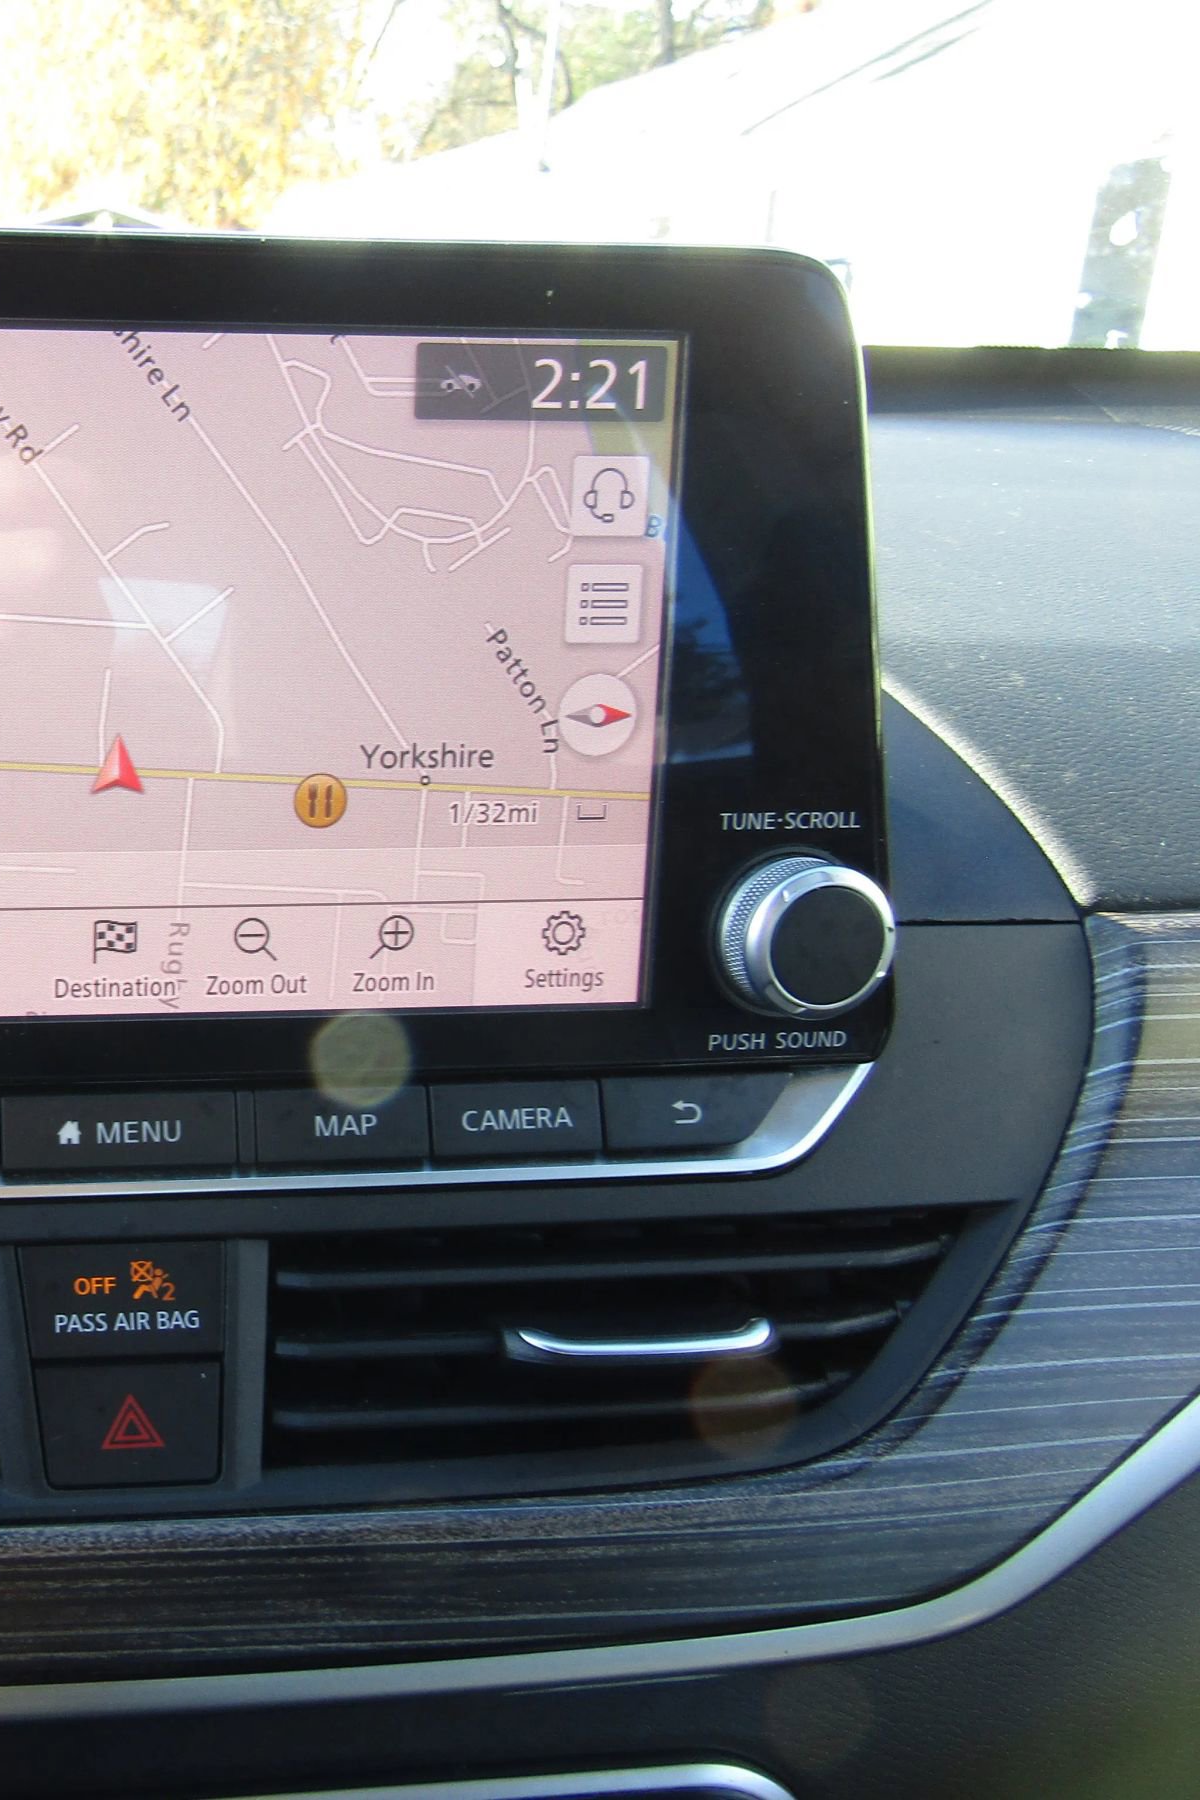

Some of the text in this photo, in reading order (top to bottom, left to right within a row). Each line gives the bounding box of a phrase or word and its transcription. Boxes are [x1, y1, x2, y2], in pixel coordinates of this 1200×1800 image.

[531, 358, 647, 409] 2:21
[160, 383, 191, 422] Ln
[5, 423, 44, 465] Rd
[486, 628, 560, 754] Patton Ln
[360, 743, 495, 769] Yorkshire
[449, 801, 539, 825] 1/32mi
[54, 977, 176, 999] Destination
[206, 974, 307, 996] Zoom Out
[353, 972, 435, 993] Zoom In
[525, 968, 605, 993] Settings
[708, 1030, 847, 1051] PUSH SOUND
[314, 1113, 378, 1137] MAP
[461, 1106, 574, 1132] CAMERA
[96, 1120, 182, 1145] MENU
[73, 1276, 117, 1296] OFF
[54, 1309, 200, 1333] PASS AIR BAG
